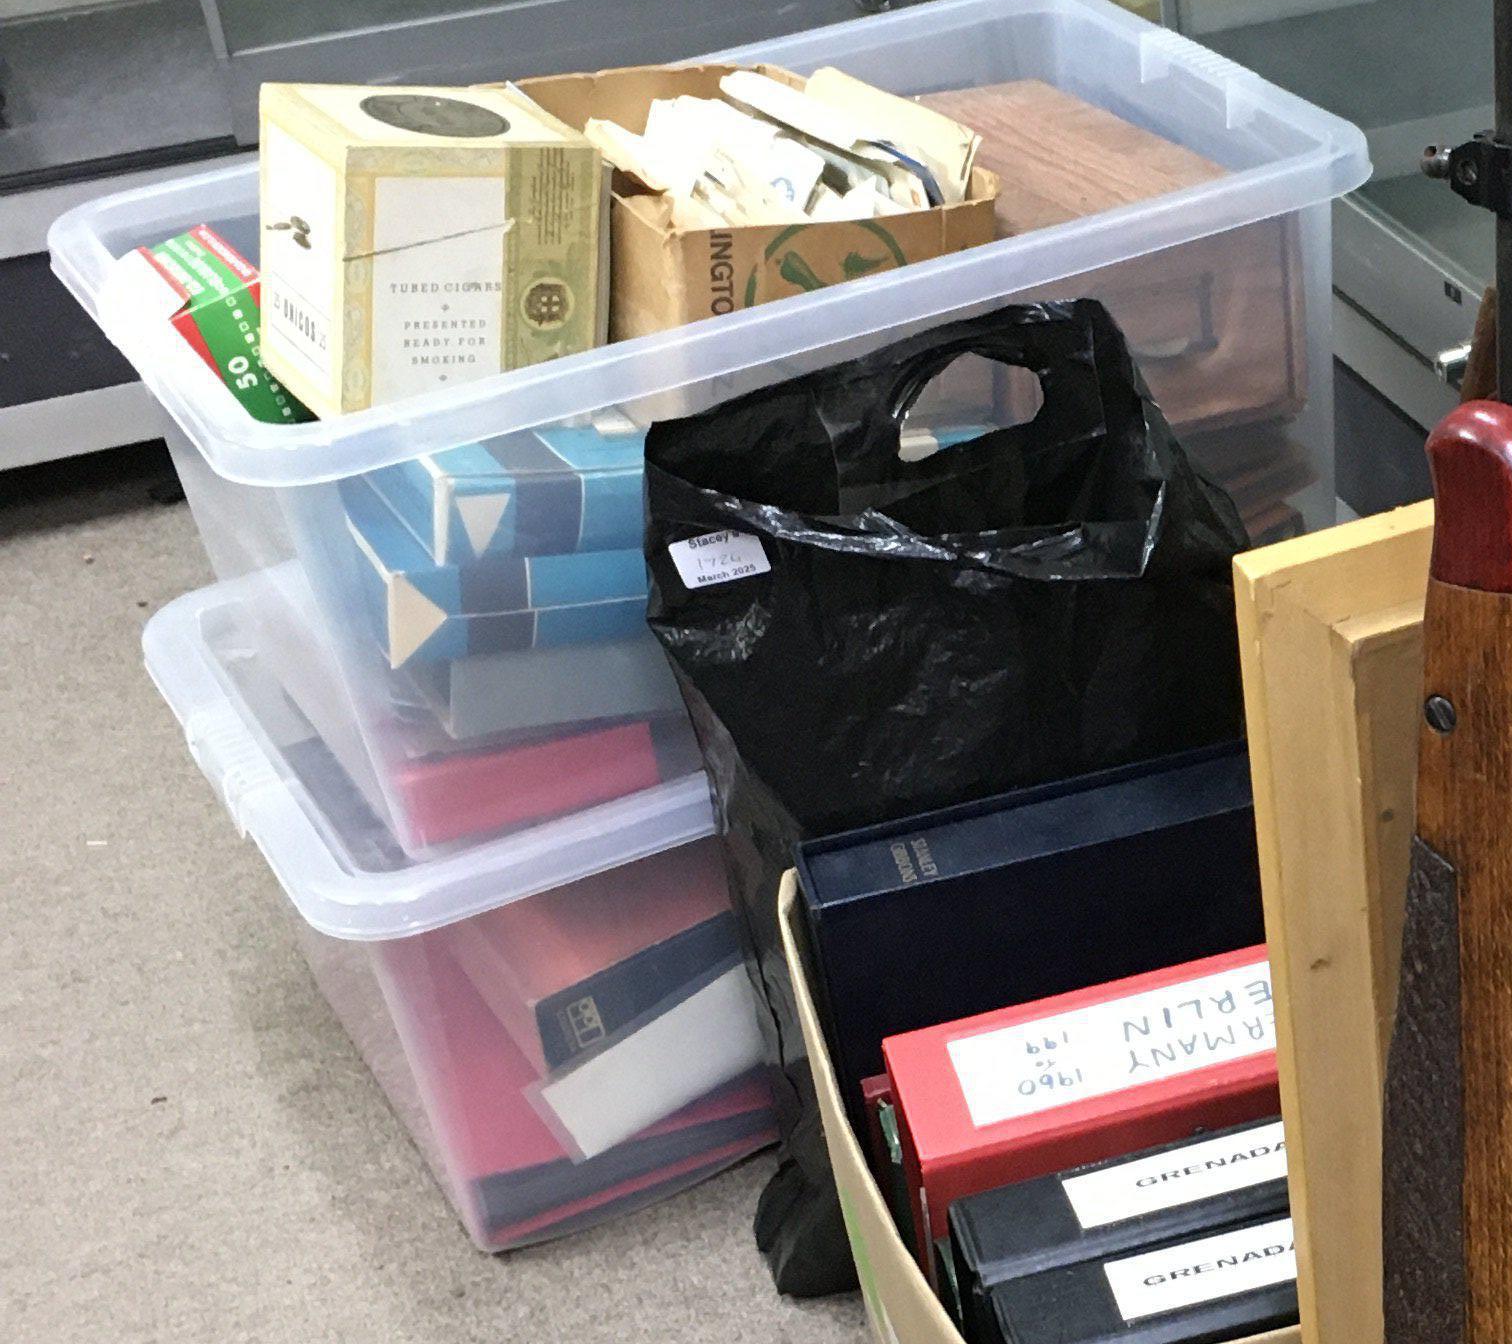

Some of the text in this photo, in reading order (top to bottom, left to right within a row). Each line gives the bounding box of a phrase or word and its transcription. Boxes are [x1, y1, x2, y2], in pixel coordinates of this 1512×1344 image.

[710, 230, 734, 316] INGTO
[390, 282, 501, 293] TUBED CIGARS
[403, 319, 487, 330] PRESENTED
[403, 337, 486, 348] READY FOR
[411, 355, 476, 365] SMOKING
[697, 573, 730, 584] March
[1123, 980, 1272, 1042] ERLIN
[1129, 1013, 1274, 1074] RMANY
[1143, 1241, 1294, 1286] GRENAD
